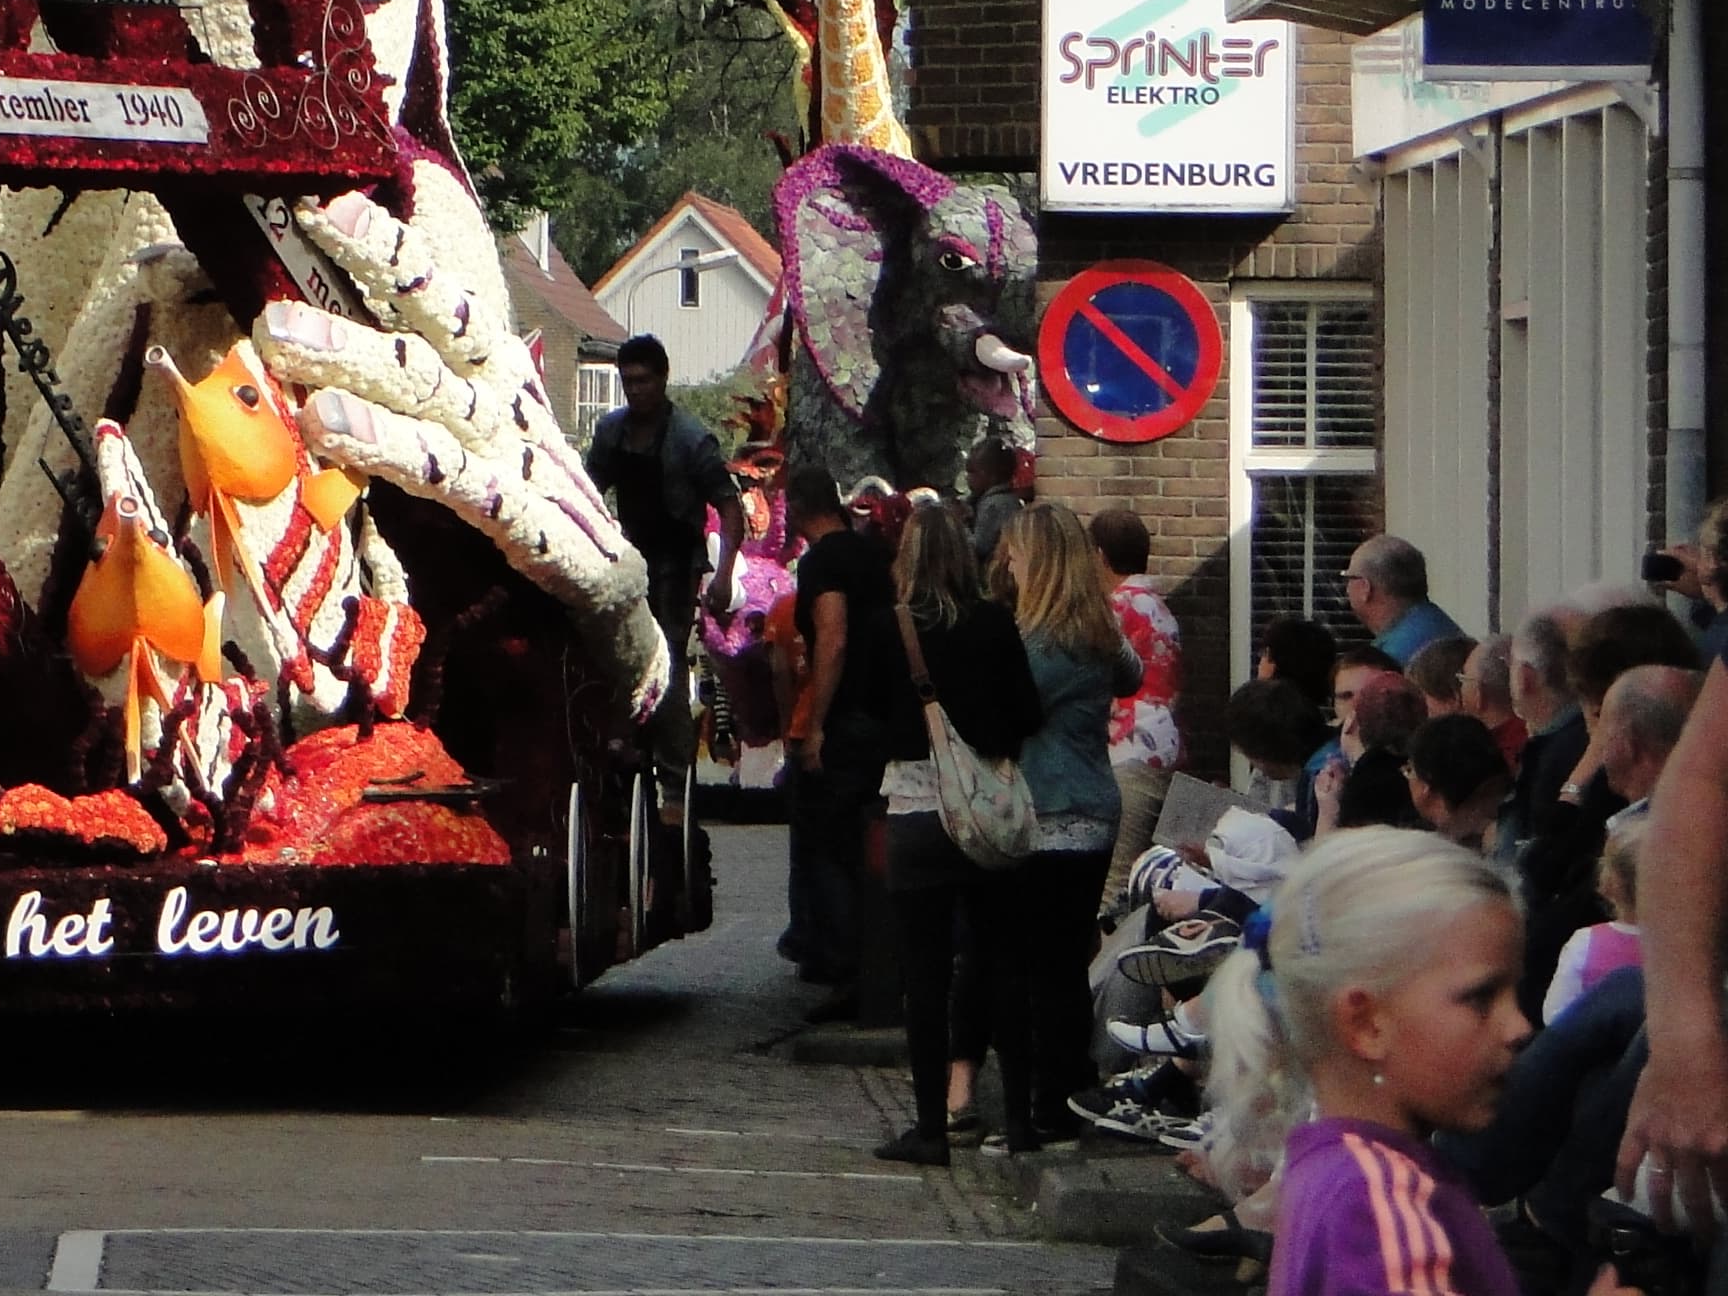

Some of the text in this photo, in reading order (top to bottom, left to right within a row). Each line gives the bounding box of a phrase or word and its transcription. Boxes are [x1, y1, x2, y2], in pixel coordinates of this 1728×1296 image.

[115, 92, 185, 129] 1940
[1107, 86, 1221, 106] ELEKTRO
[1058, 161, 1276, 187] VREDENBURG
[5, 891, 114, 959] het
[156, 886, 340, 955] leven
